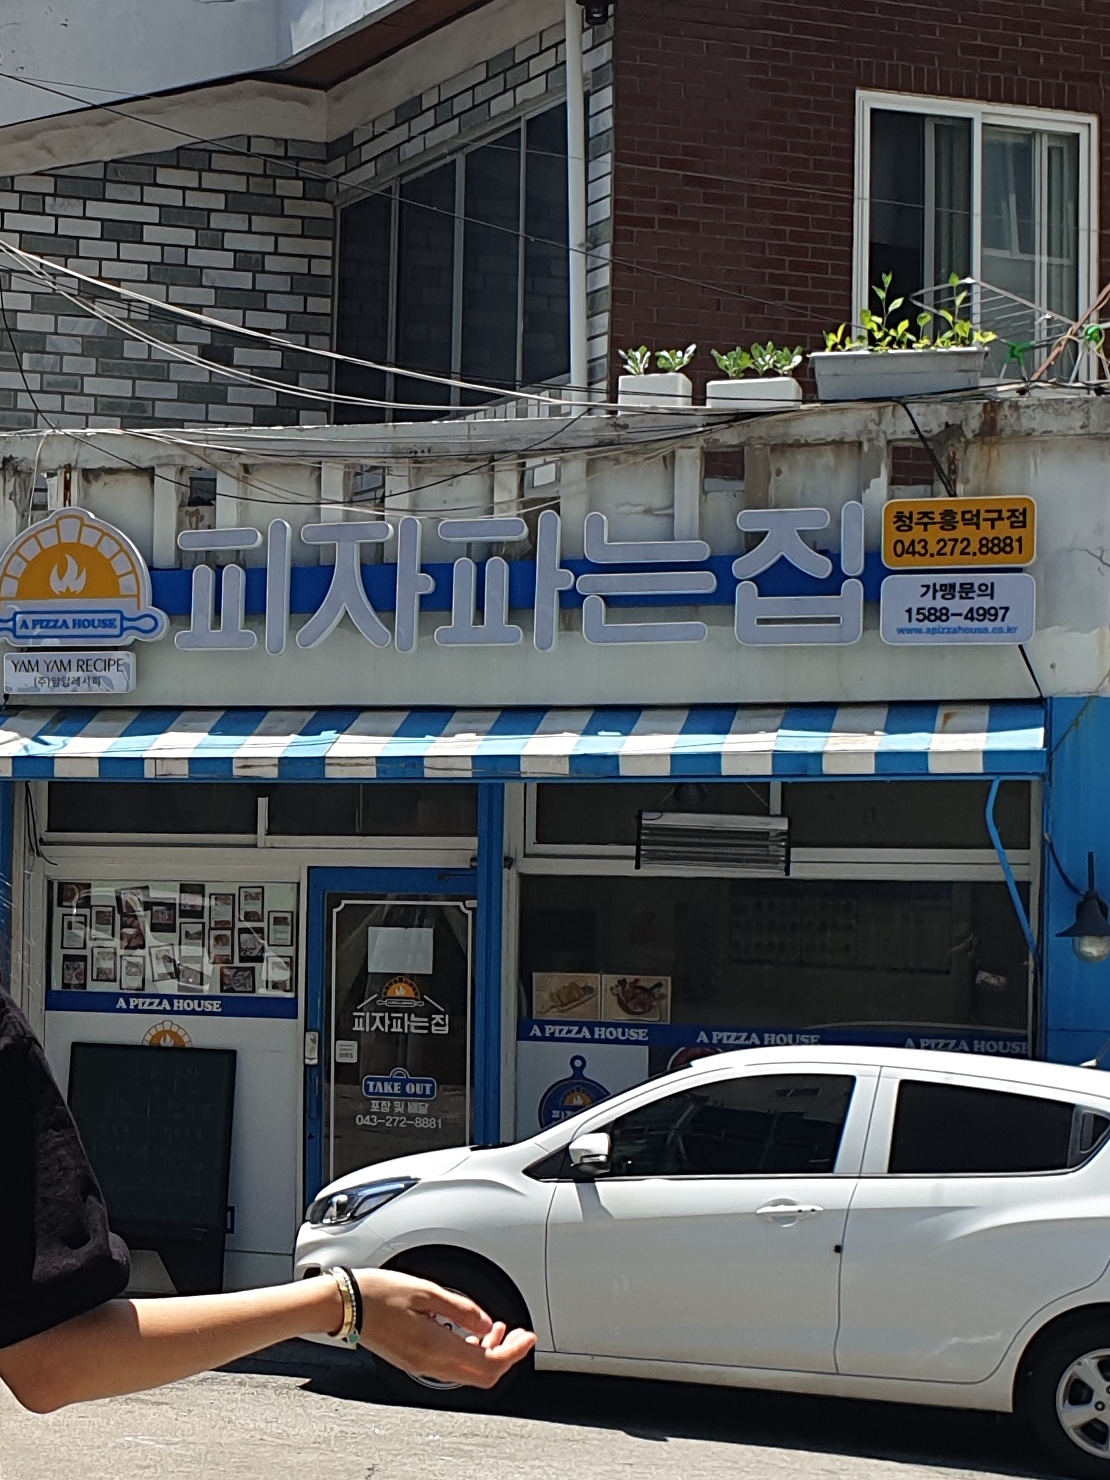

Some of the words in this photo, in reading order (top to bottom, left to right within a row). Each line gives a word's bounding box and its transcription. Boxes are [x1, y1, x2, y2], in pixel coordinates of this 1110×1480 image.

[892, 507, 1027, 532] 청주흥덕구점
[893, 536, 1023, 558] 043.272.8881
[174, 501, 863, 656] 피자파는집
[920, 582, 995, 600] 가맹문의
[905, 606, 1010, 623] 1588-4997
[19, 619, 29, 630] A
[31, 619, 70, 629] PIZZA
[72, 618, 117, 629] HOUSE
[11, 658, 39, 673] YAM
[43, 658, 72, 673] YAM
[76, 658, 125, 673] RECIPE
[116, 998, 127, 1009] A
[129, 998, 171, 1011] PIZZA
[173, 999, 222, 1012] HOUSE
[352, 1011, 450, 1035] 피자파는집
[529, 1024, 542, 1037] A
[544, 1025, 591, 1039] PIZZA
[593, 1027, 649, 1041] HOUSE
[696, 1031, 709, 1043] A
[711, 1031, 760, 1045] PIZZA
[763, 1033, 821, 1045] HOUSE
[919, 1038, 970, 1052] PIZZA
[367, 1081, 401, 1094] TAKE
[405, 1082, 433, 1095] OUT
[370, 1100, 391, 1113] 포장
[393, 1101, 405, 1113] 및
[355, 1114, 442, 1129] 043-272-8881
